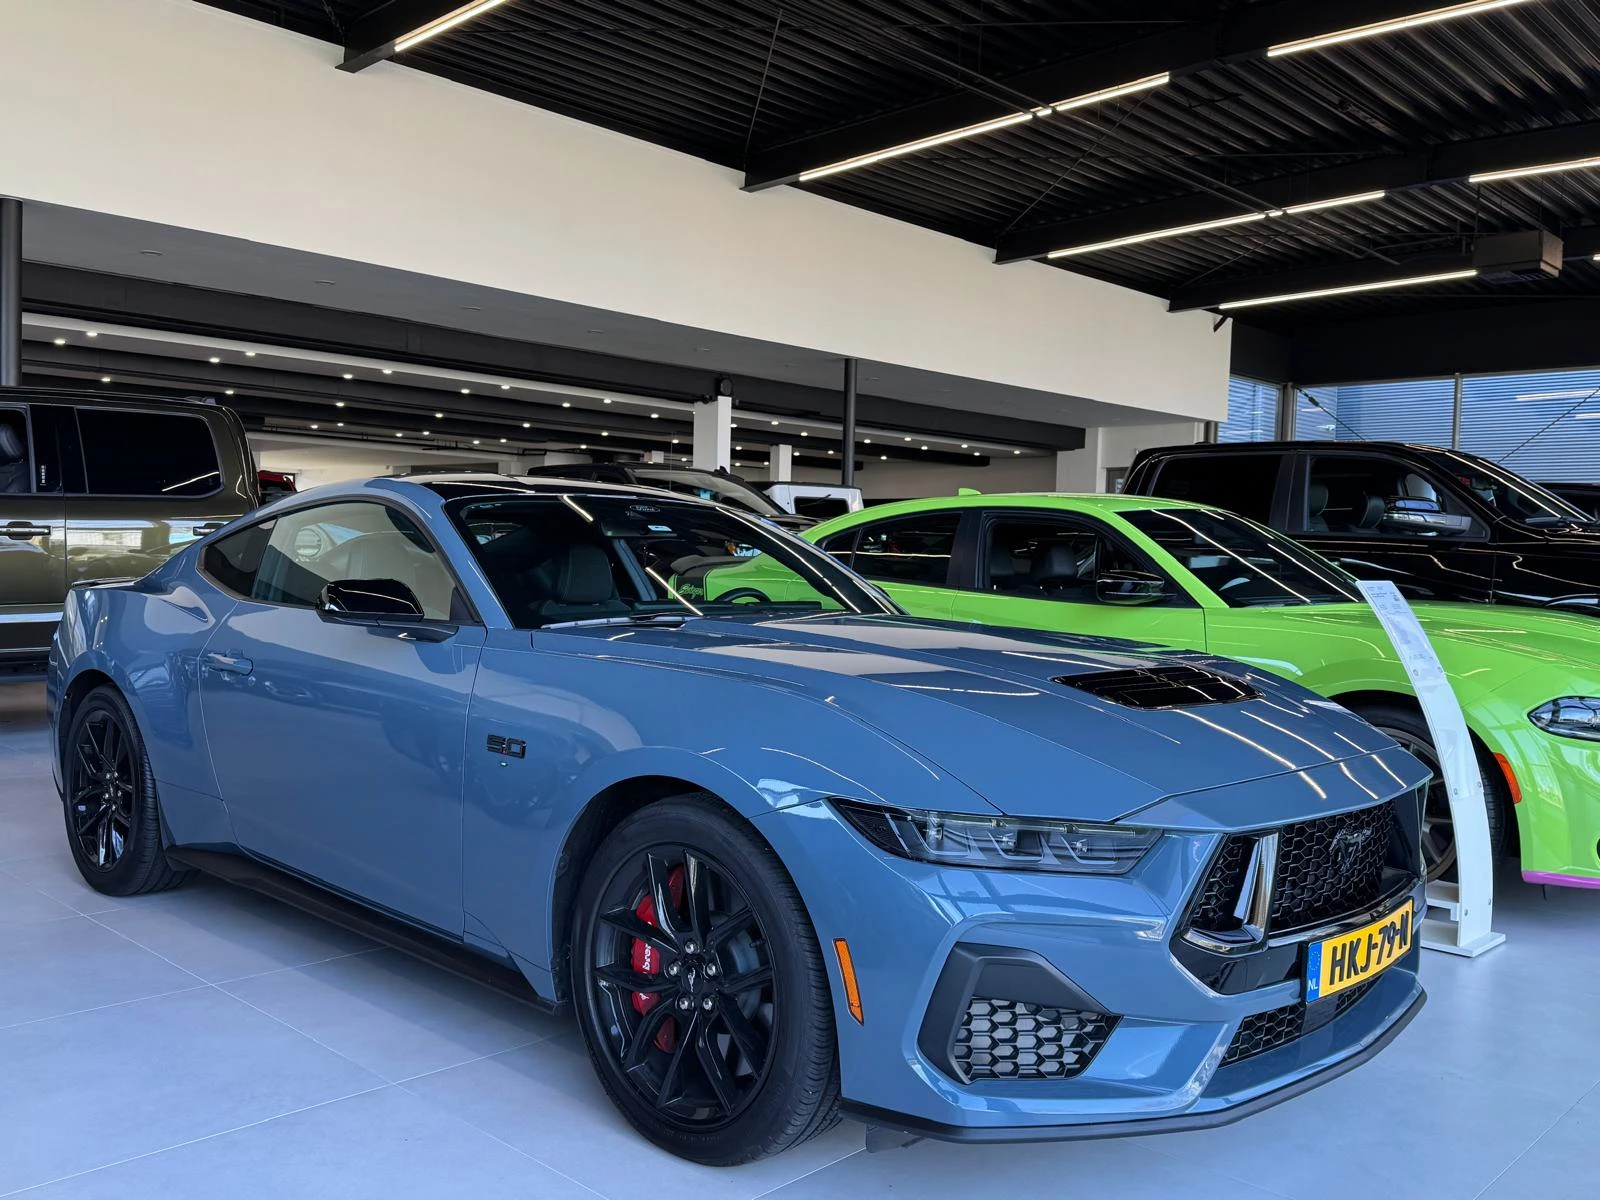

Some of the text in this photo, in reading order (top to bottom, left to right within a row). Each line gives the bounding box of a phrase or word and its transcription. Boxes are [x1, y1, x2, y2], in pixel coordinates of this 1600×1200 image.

[487, 734, 526, 759] 5.0
[1329, 910, 1410, 986] HKJ-79-N
[1308, 978, 1319, 992] NL
